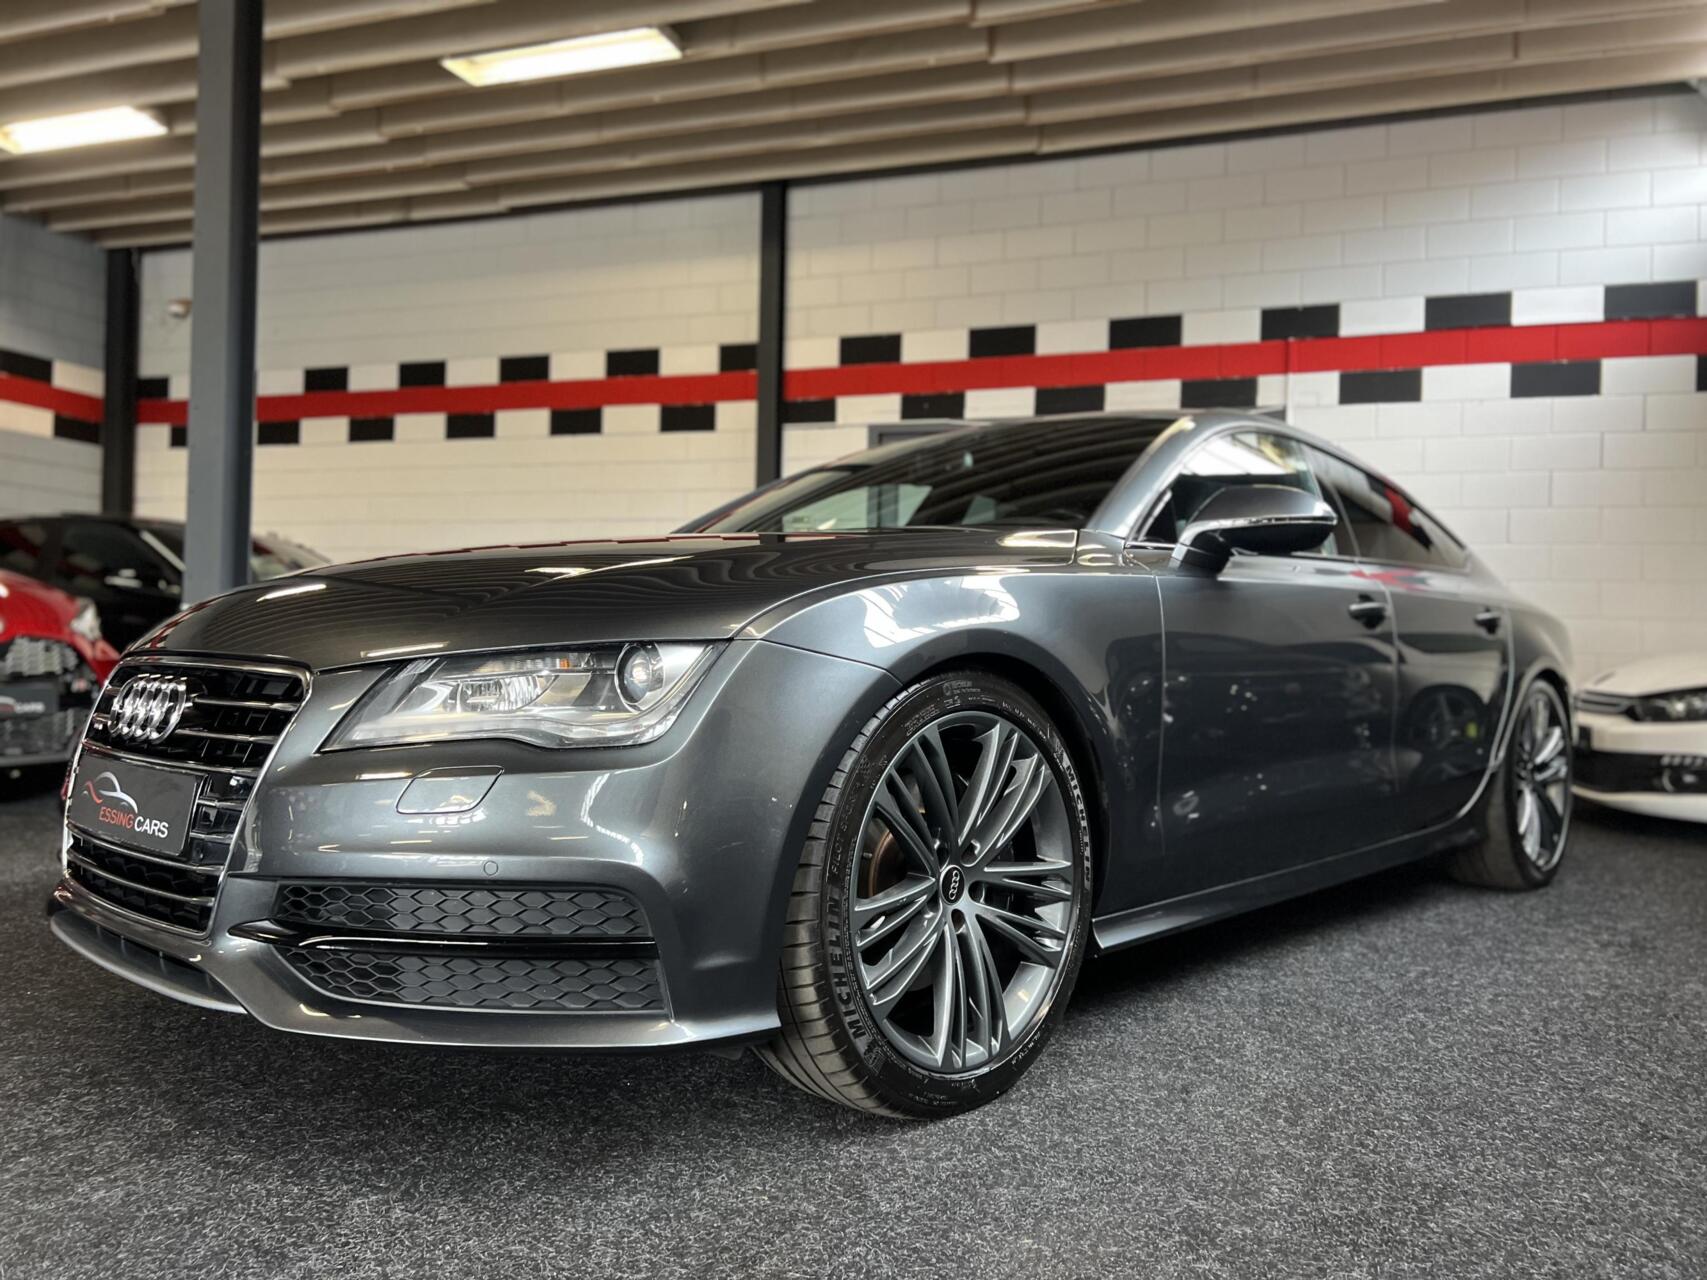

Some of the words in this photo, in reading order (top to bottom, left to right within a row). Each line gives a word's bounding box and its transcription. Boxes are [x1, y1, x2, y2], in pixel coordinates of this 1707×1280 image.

[99, 806, 134, 829] ESSING
[134, 816, 169, 838] CARS
[827, 895, 868, 1040] MICHELIN
